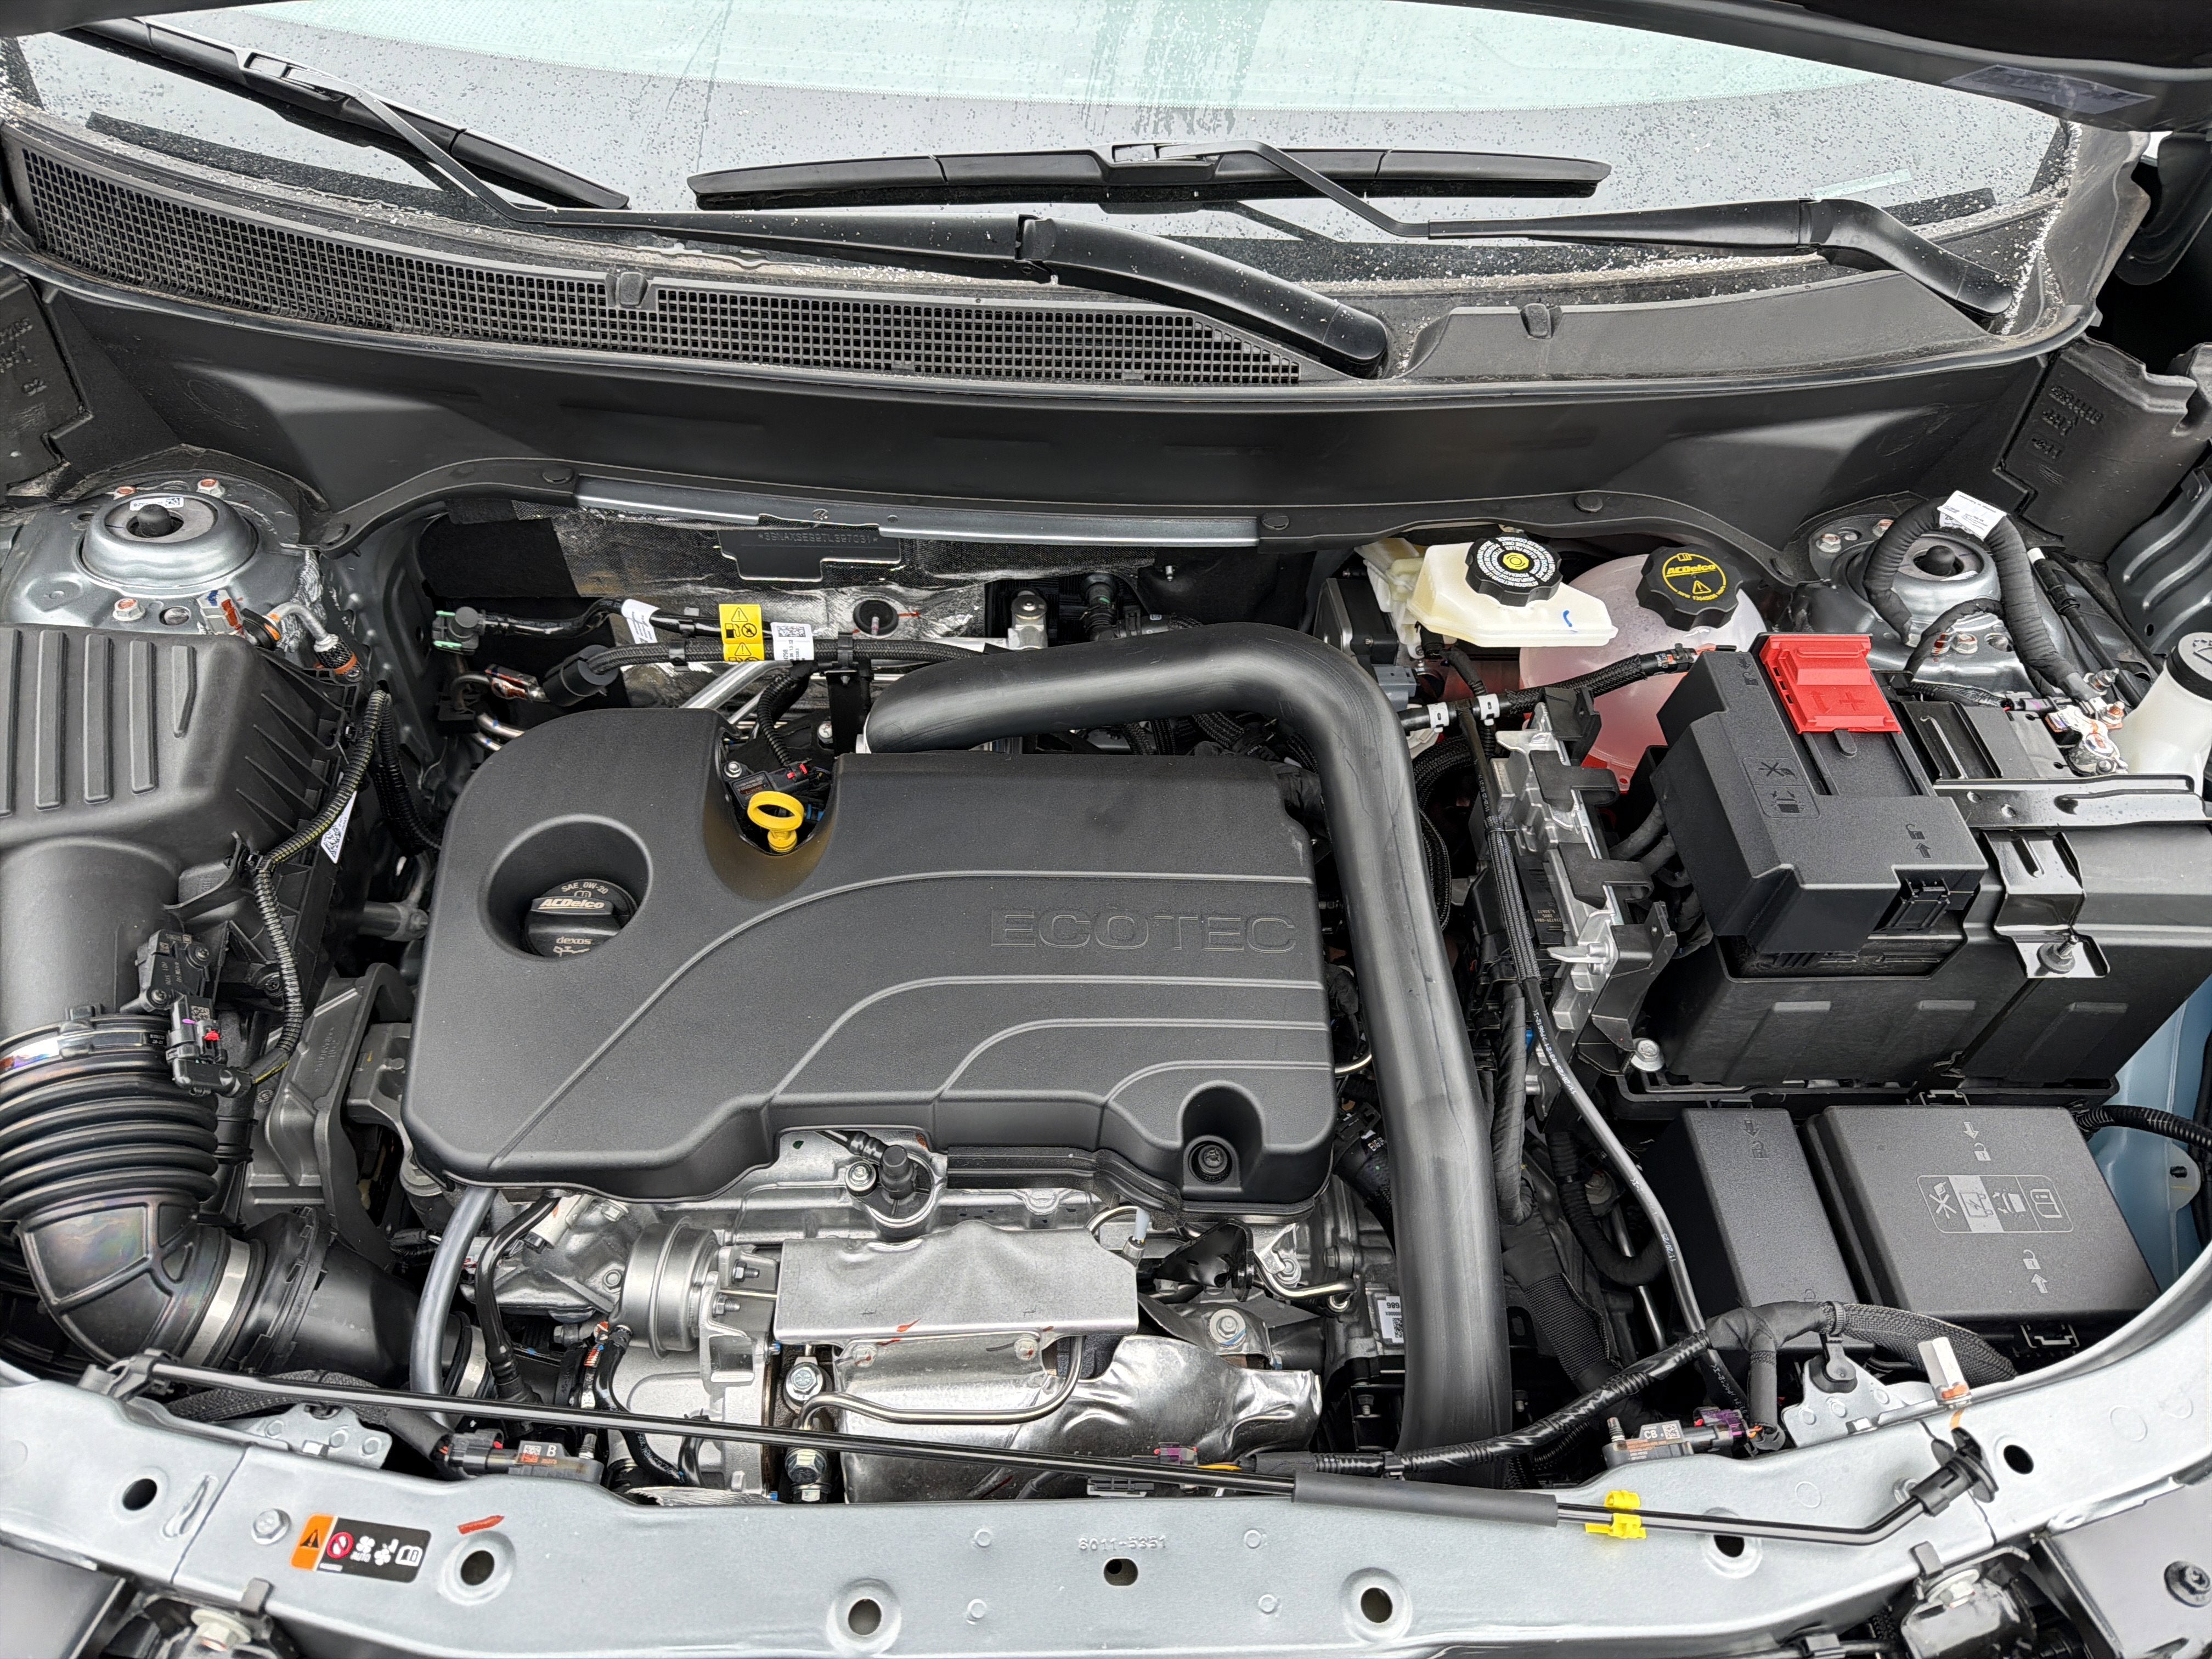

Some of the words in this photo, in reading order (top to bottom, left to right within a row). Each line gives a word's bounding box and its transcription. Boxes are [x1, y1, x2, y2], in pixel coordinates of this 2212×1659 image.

[1667, 565, 1716, 574] ACDelco
[561, 882, 579, 893] SAE
[583, 882, 609, 894] 0W-20
[538, 899, 605, 909] ACDelco
[991, 910, 1296, 953] ECOTEC
[556, 936, 592, 945] dexos
[1644, 1430, 1658, 1440] CB
[546, 1444, 557, 1457] B
